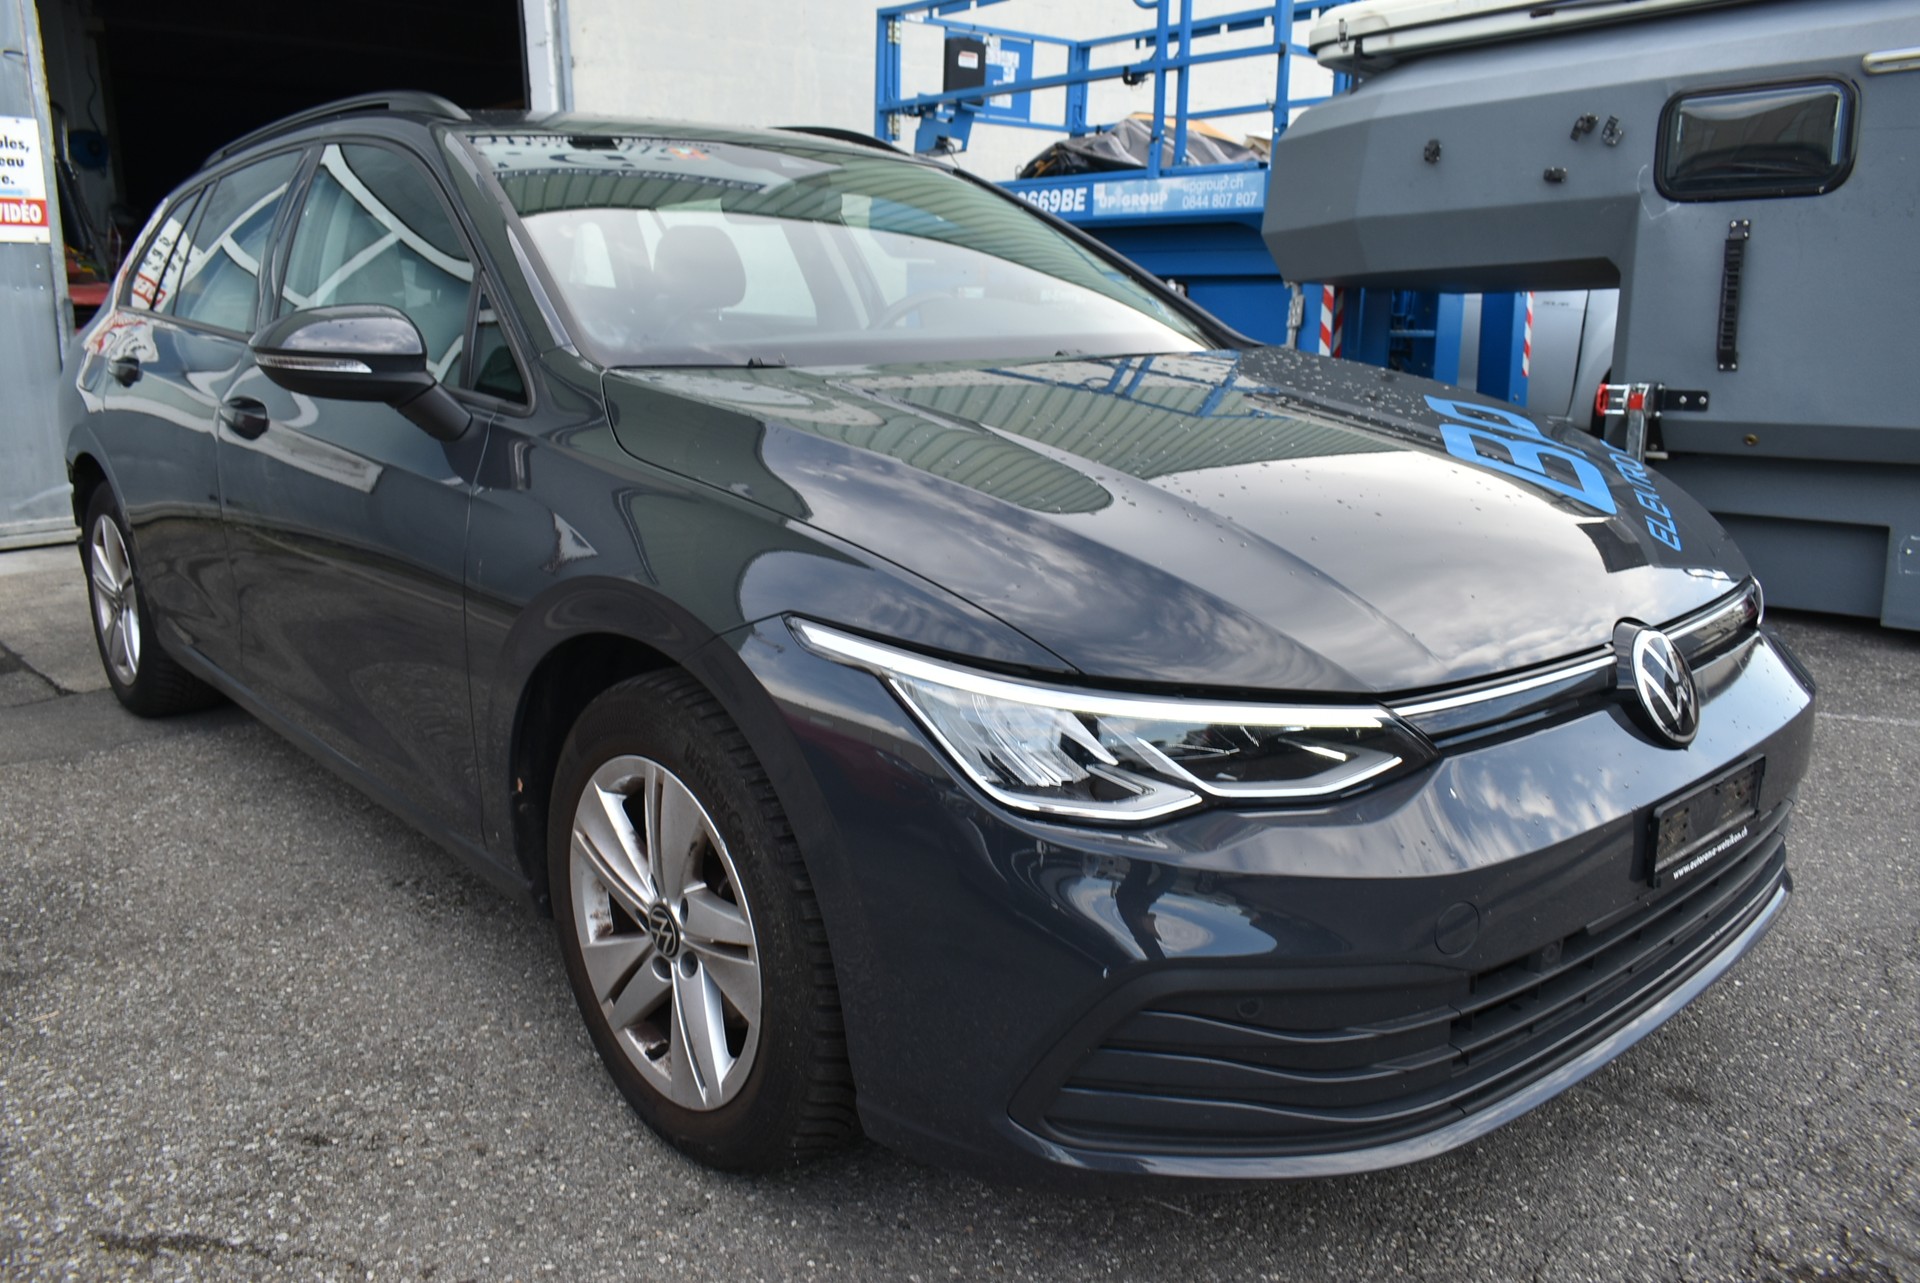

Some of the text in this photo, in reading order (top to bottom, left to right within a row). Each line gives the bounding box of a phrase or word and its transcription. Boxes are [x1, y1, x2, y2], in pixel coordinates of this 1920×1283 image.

[1122, 191, 1168, 207] GROUP
[1182, 194, 1209, 210] 0844
[1211, 192, 1233, 208] 807
[1235, 190, 1258, 206] 807
